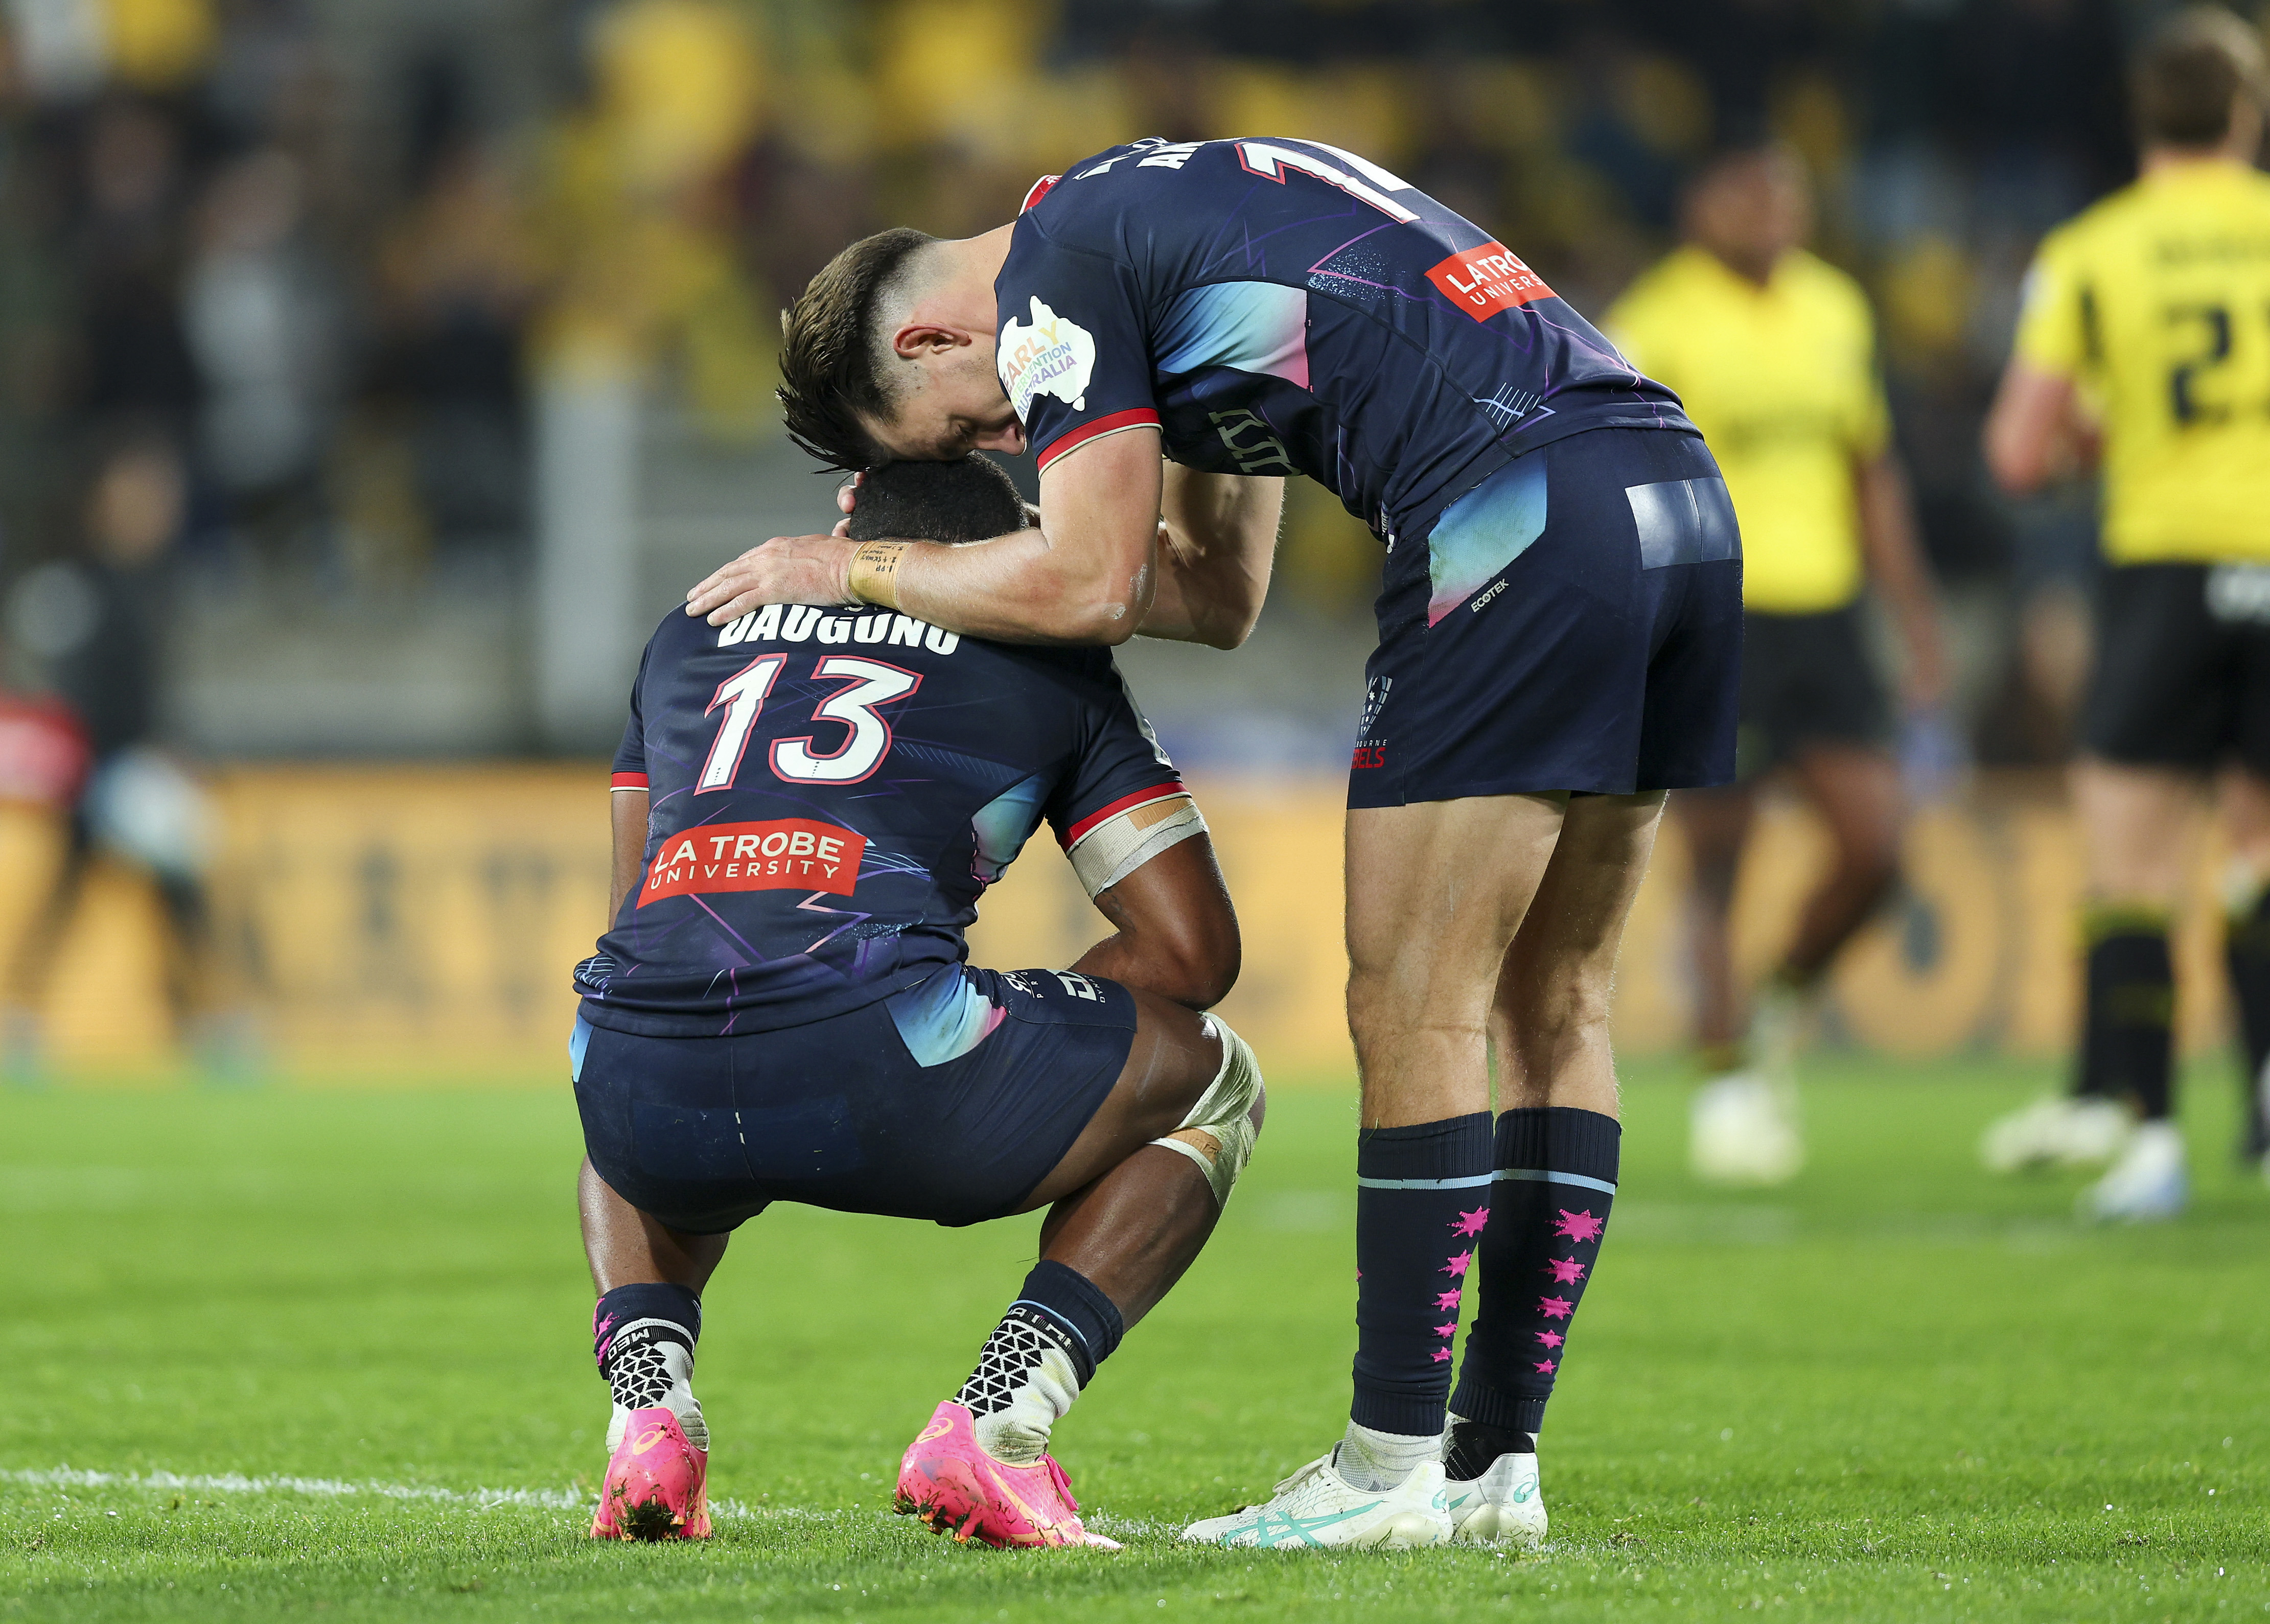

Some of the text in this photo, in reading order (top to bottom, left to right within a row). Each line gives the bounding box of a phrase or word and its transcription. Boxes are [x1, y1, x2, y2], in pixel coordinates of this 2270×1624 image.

[1003, 319, 1059, 395] EARLY
[1011, 341, 1072, 406] NTERVENTION
[1016, 355, 1077, 419] AUSTRALIA
[1470, 578, 1510, 613] ECOTEK
[695, 653, 924, 795] 13
[1354, 739, 1387, 748] BOURNE
[651, 859, 839, 890] UNIVERSITY
[655, 831, 845, 874] LA TROBE
